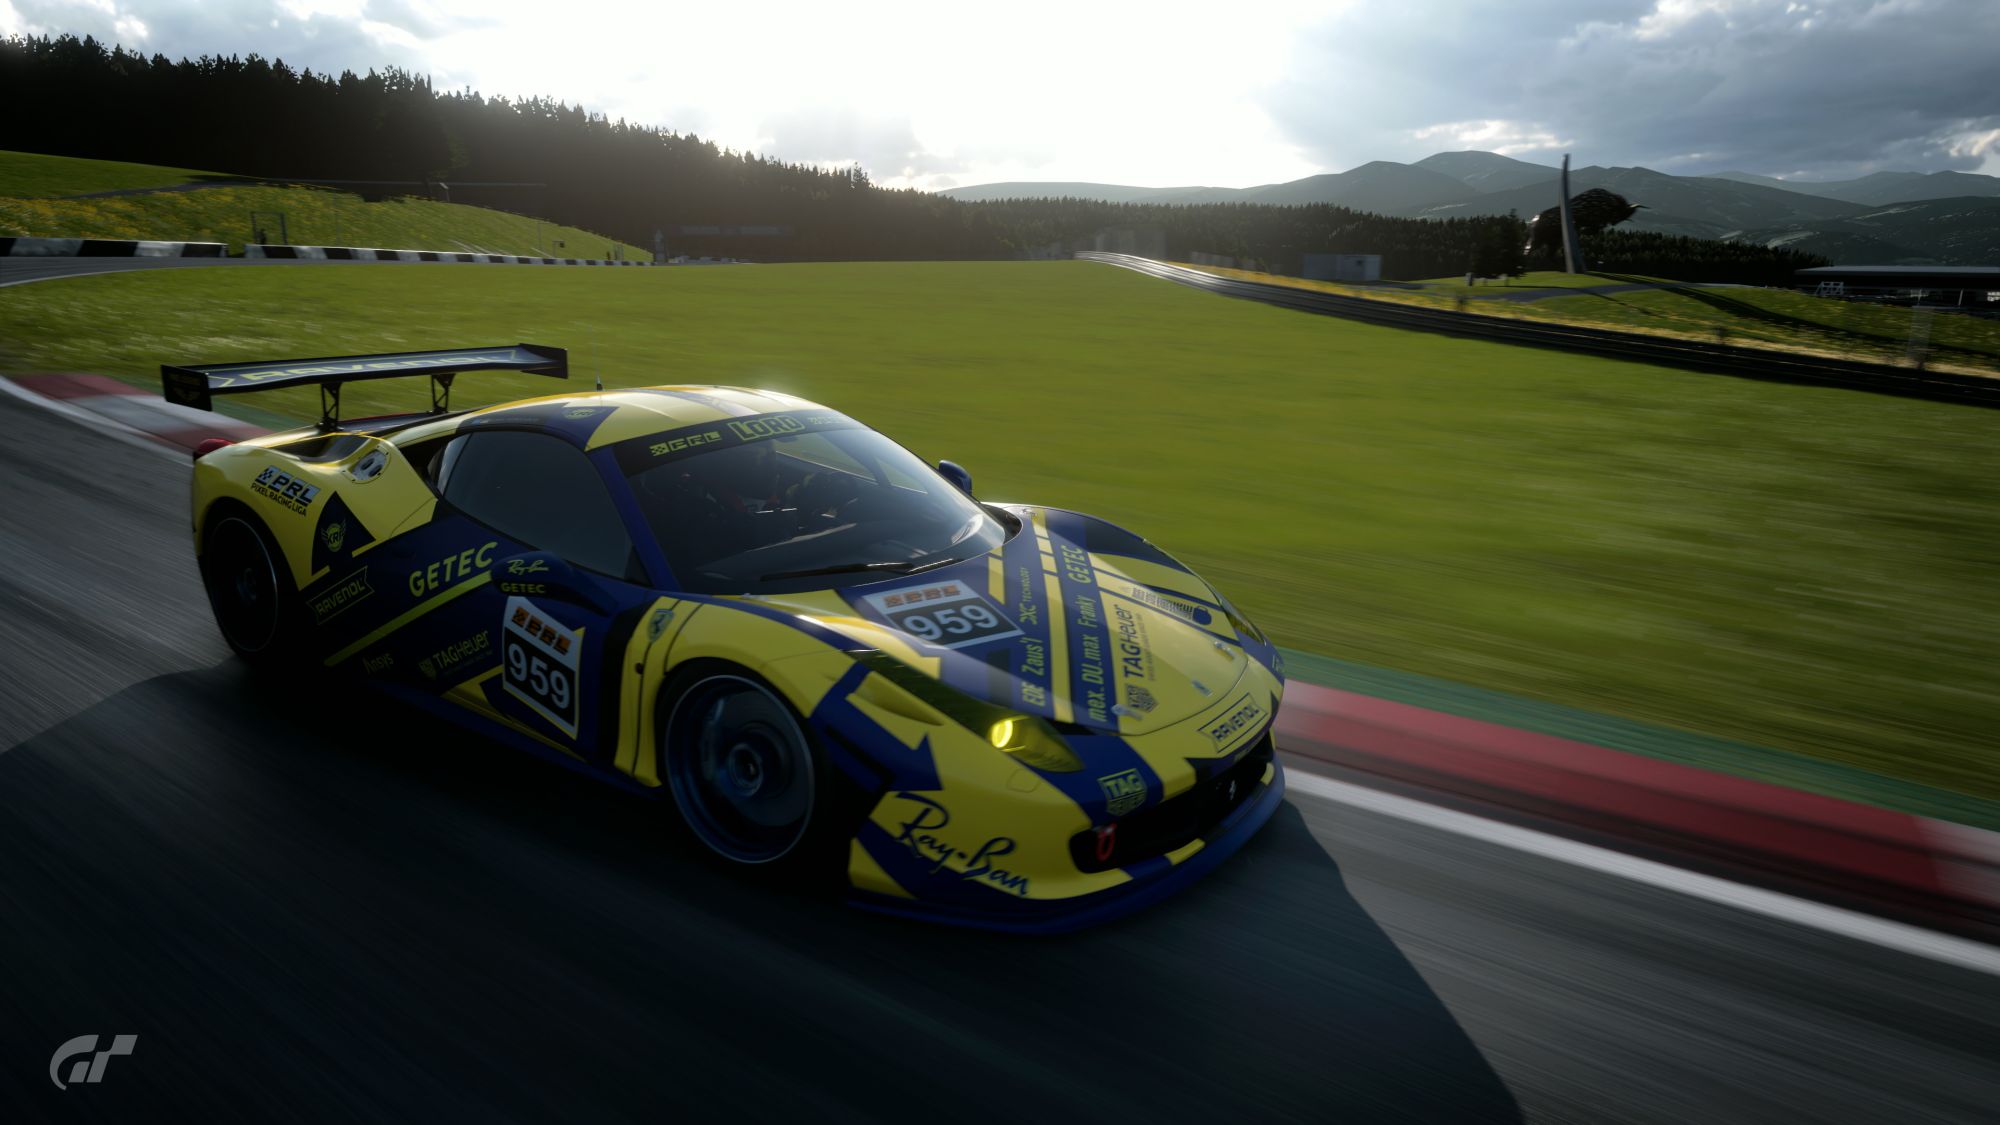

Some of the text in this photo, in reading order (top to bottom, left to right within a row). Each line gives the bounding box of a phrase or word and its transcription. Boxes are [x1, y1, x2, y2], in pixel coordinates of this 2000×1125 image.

[728, 415, 804, 441] LORD
[271, 474, 313, 504] PRL
[408, 541, 498, 598] GETEC
[1062, 545, 1092, 583] GETEC
[500, 581, 547, 595] GETEC
[902, 604, 999, 642] 959
[507, 642, 572, 710] 959
[1105, 774, 1142, 800] TAG
